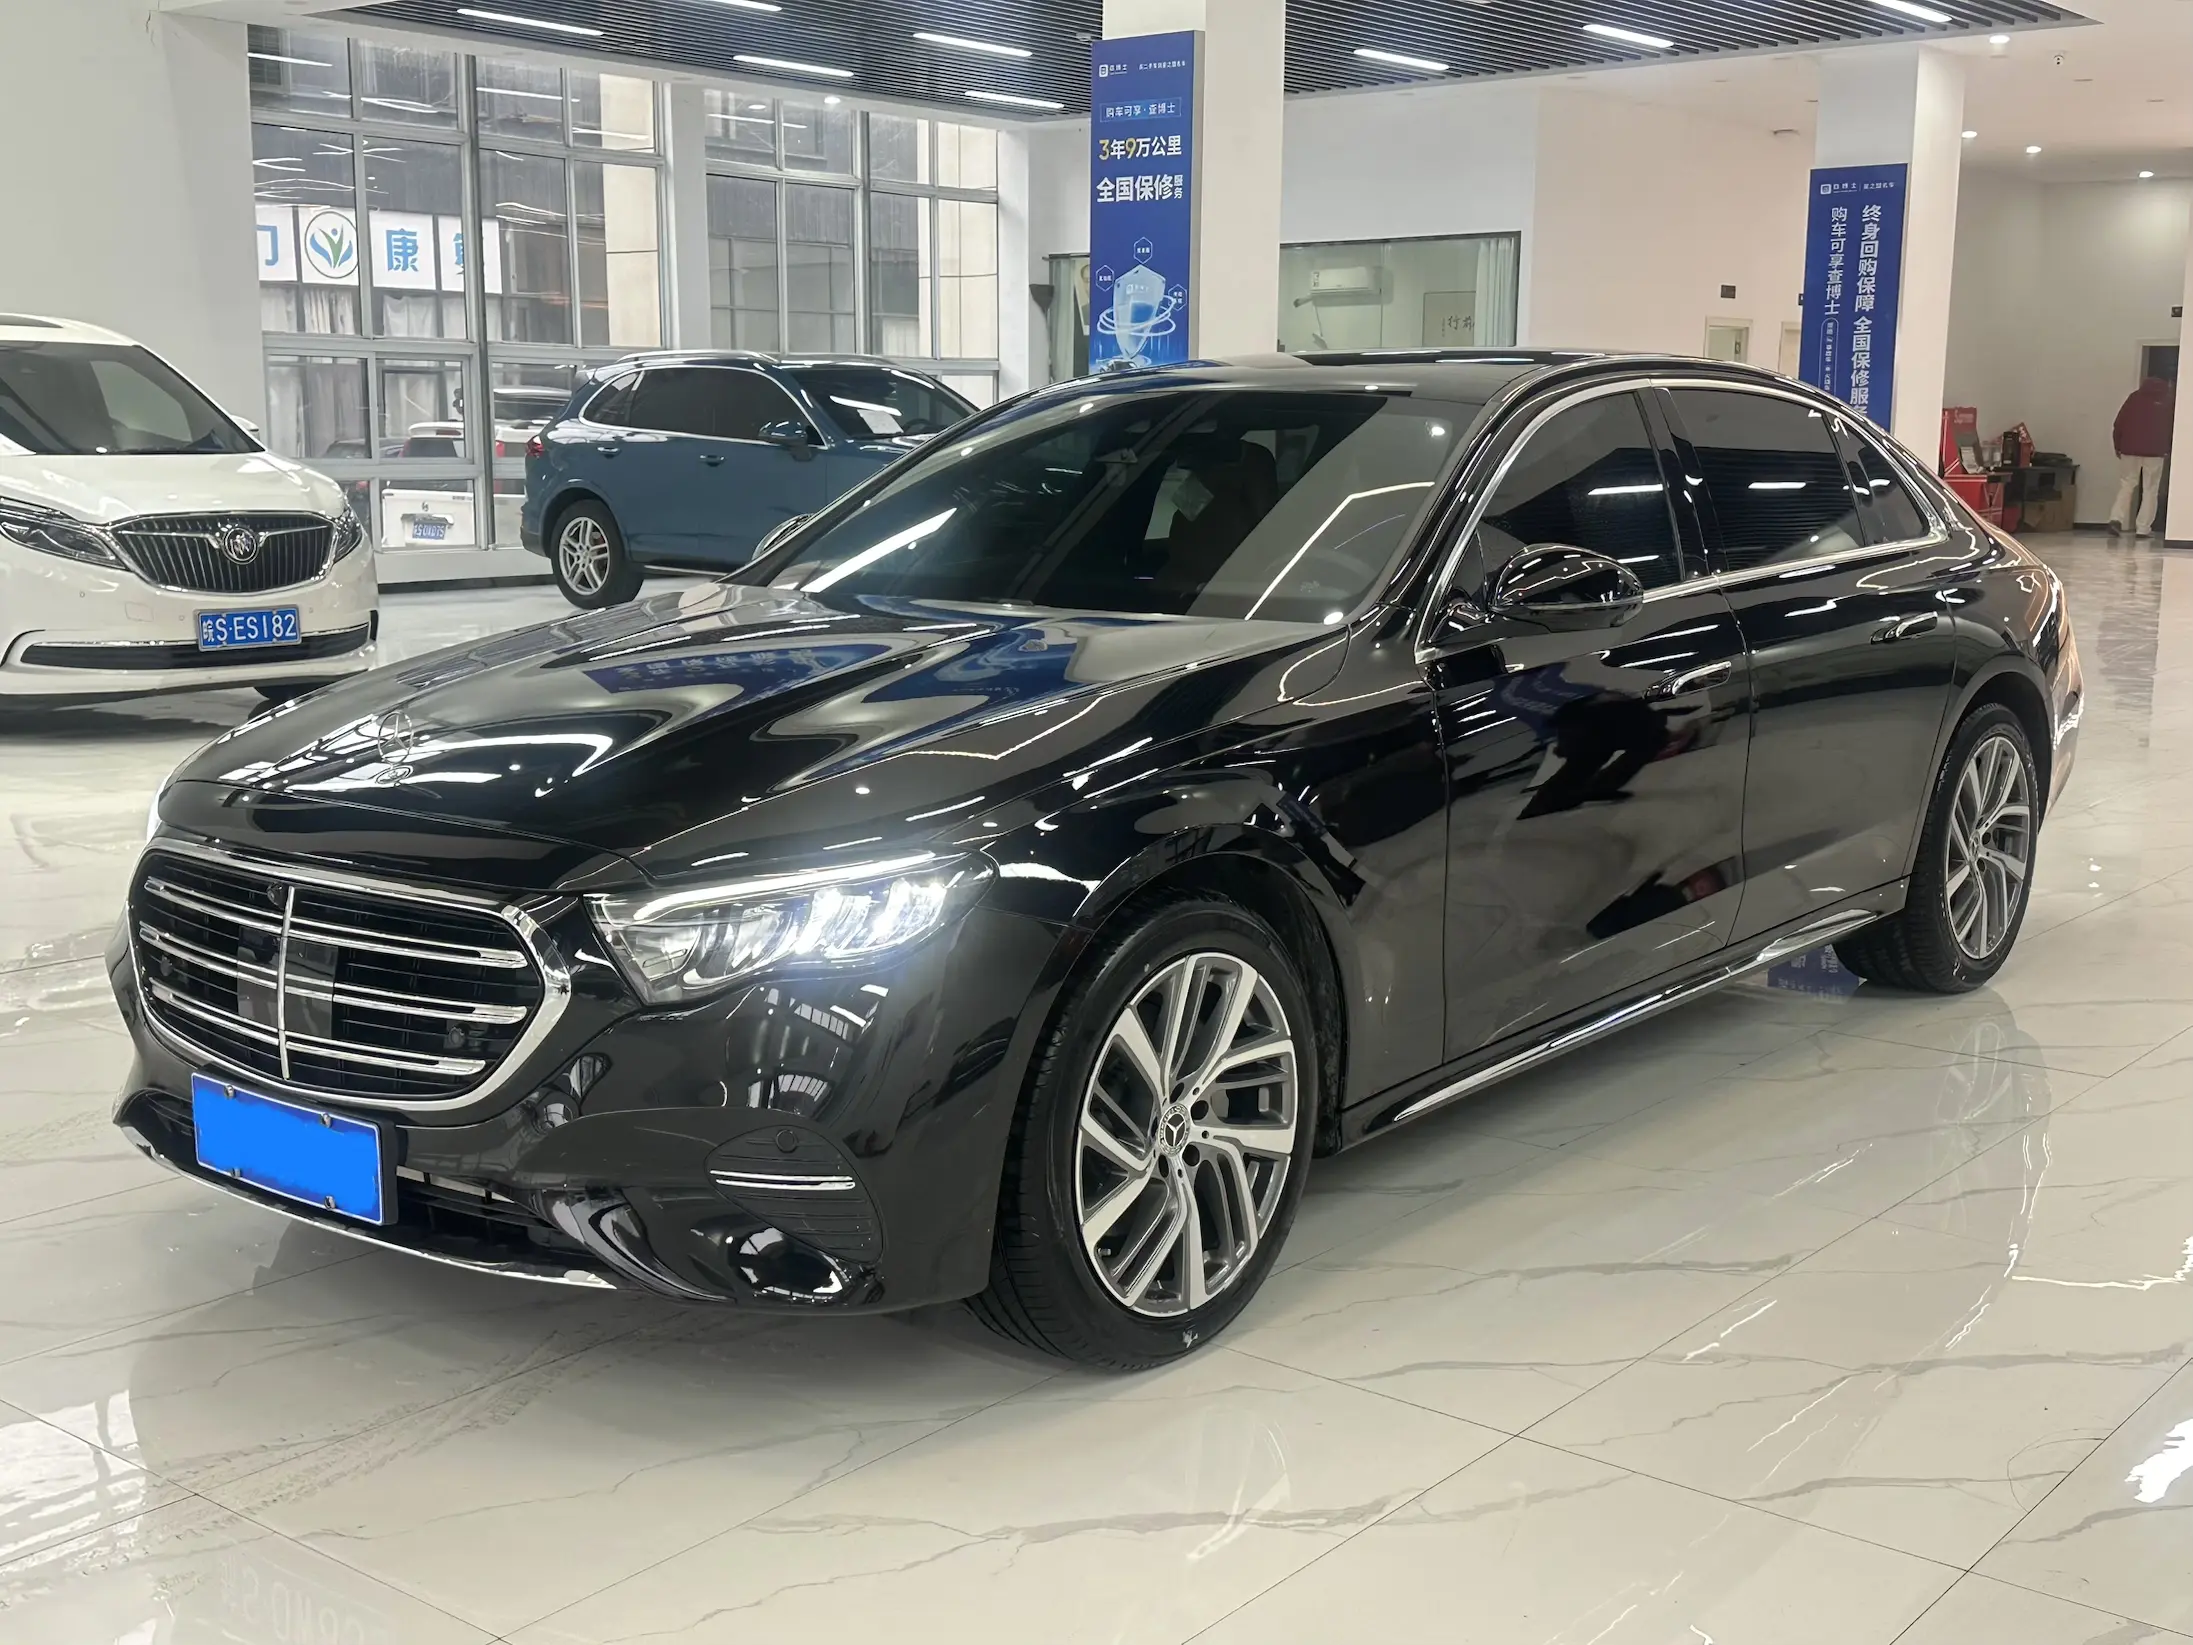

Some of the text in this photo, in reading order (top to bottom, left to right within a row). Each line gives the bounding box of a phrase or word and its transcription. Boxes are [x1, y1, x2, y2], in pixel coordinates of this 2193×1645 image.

[1098, 134, 1182, 161] 3年9万公里
[1824, 206, 1848, 316] 购车可享查博士
[1854, 204, 1883, 313] 终身回购保障
